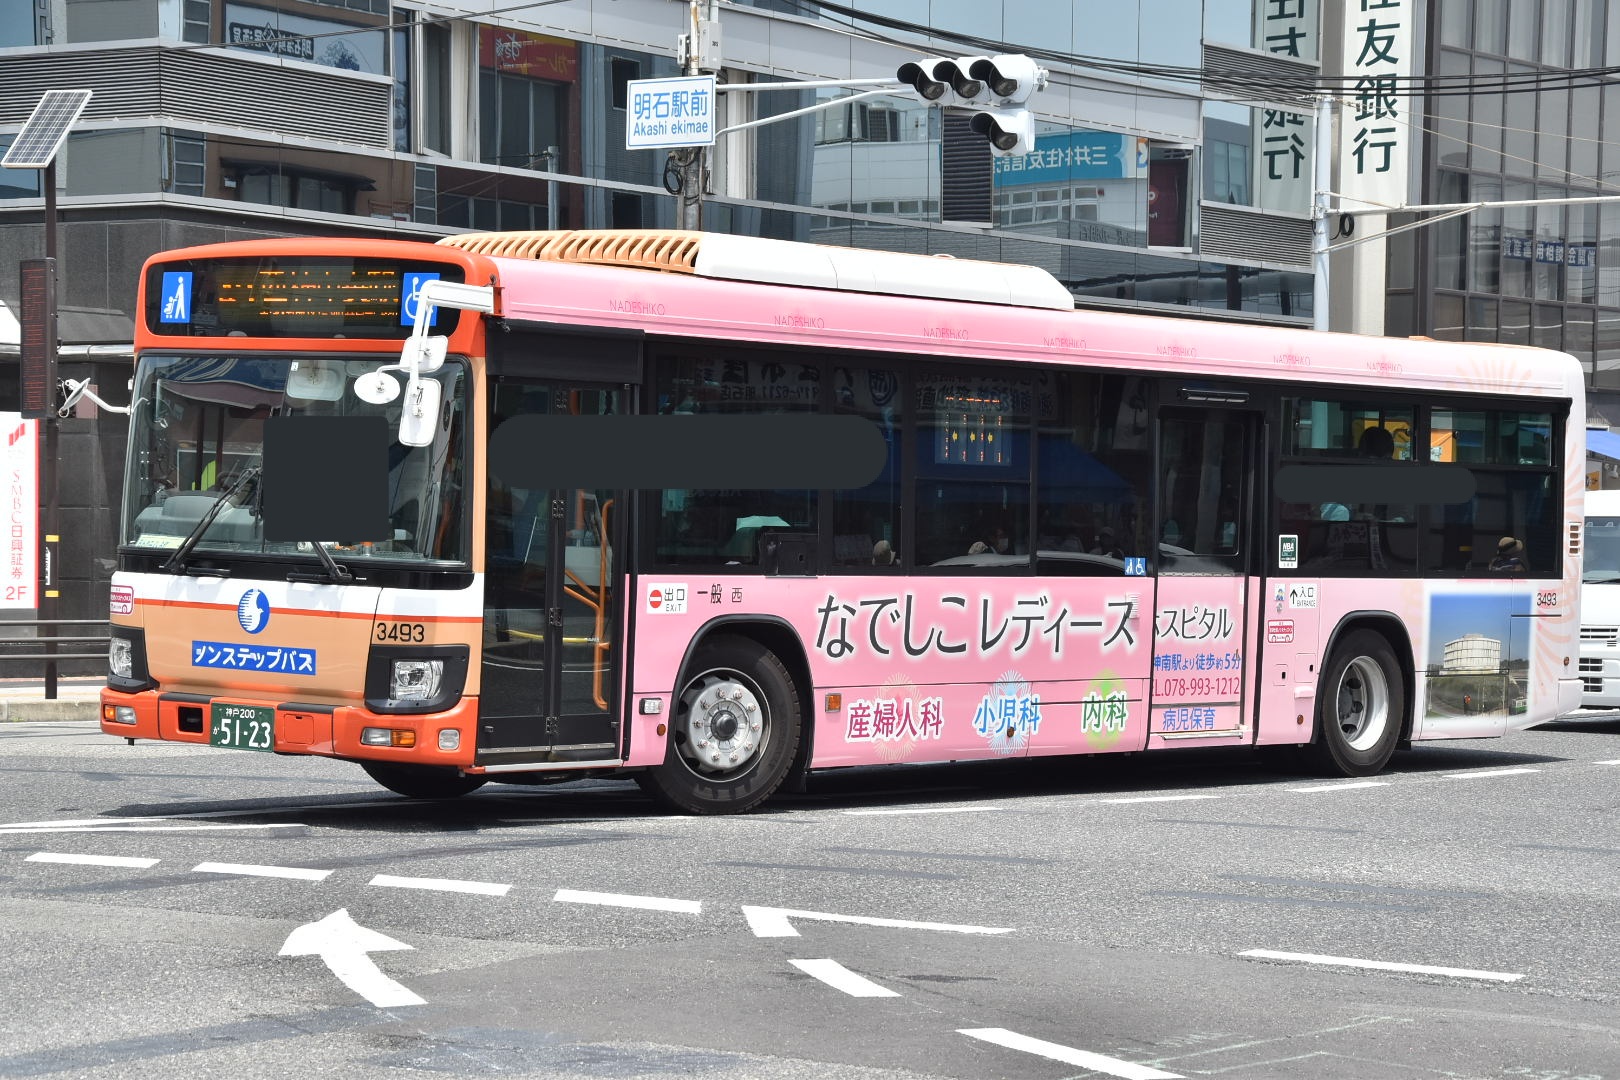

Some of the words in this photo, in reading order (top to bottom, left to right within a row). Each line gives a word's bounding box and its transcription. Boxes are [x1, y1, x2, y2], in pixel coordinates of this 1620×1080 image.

[1352, 0, 1401, 174] 友銀行
[634, 89, 708, 120] 明石駅前
[633, 121, 667, 136] Akashi
[671, 120, 708, 135] ekimae
[609, 300, 665, 316] NADESHIKO
[774, 315, 825, 329] NADESHIKO
[11, 470, 23, 580] SMBC日興証券
[5, 586, 27, 601] 2F
[664, 587, 685, 601] 出口
[697, 584, 722, 604] 一般
[731, 587, 743, 603] 西
[1299, 586, 1314, 598] 入口
[1536, 592, 1557, 606] 3493
[376, 622, 425, 643] 3493
[816, 594, 1135, 658] なでしこレディース
[194, 645, 314, 672] ノンステップバス
[847, 698, 943, 740] 産婦人科
[973, 696, 1041, 734] 小児科
[1081, 691, 1127, 731] 内科
[1162, 707, 1216, 731] 病児保育
